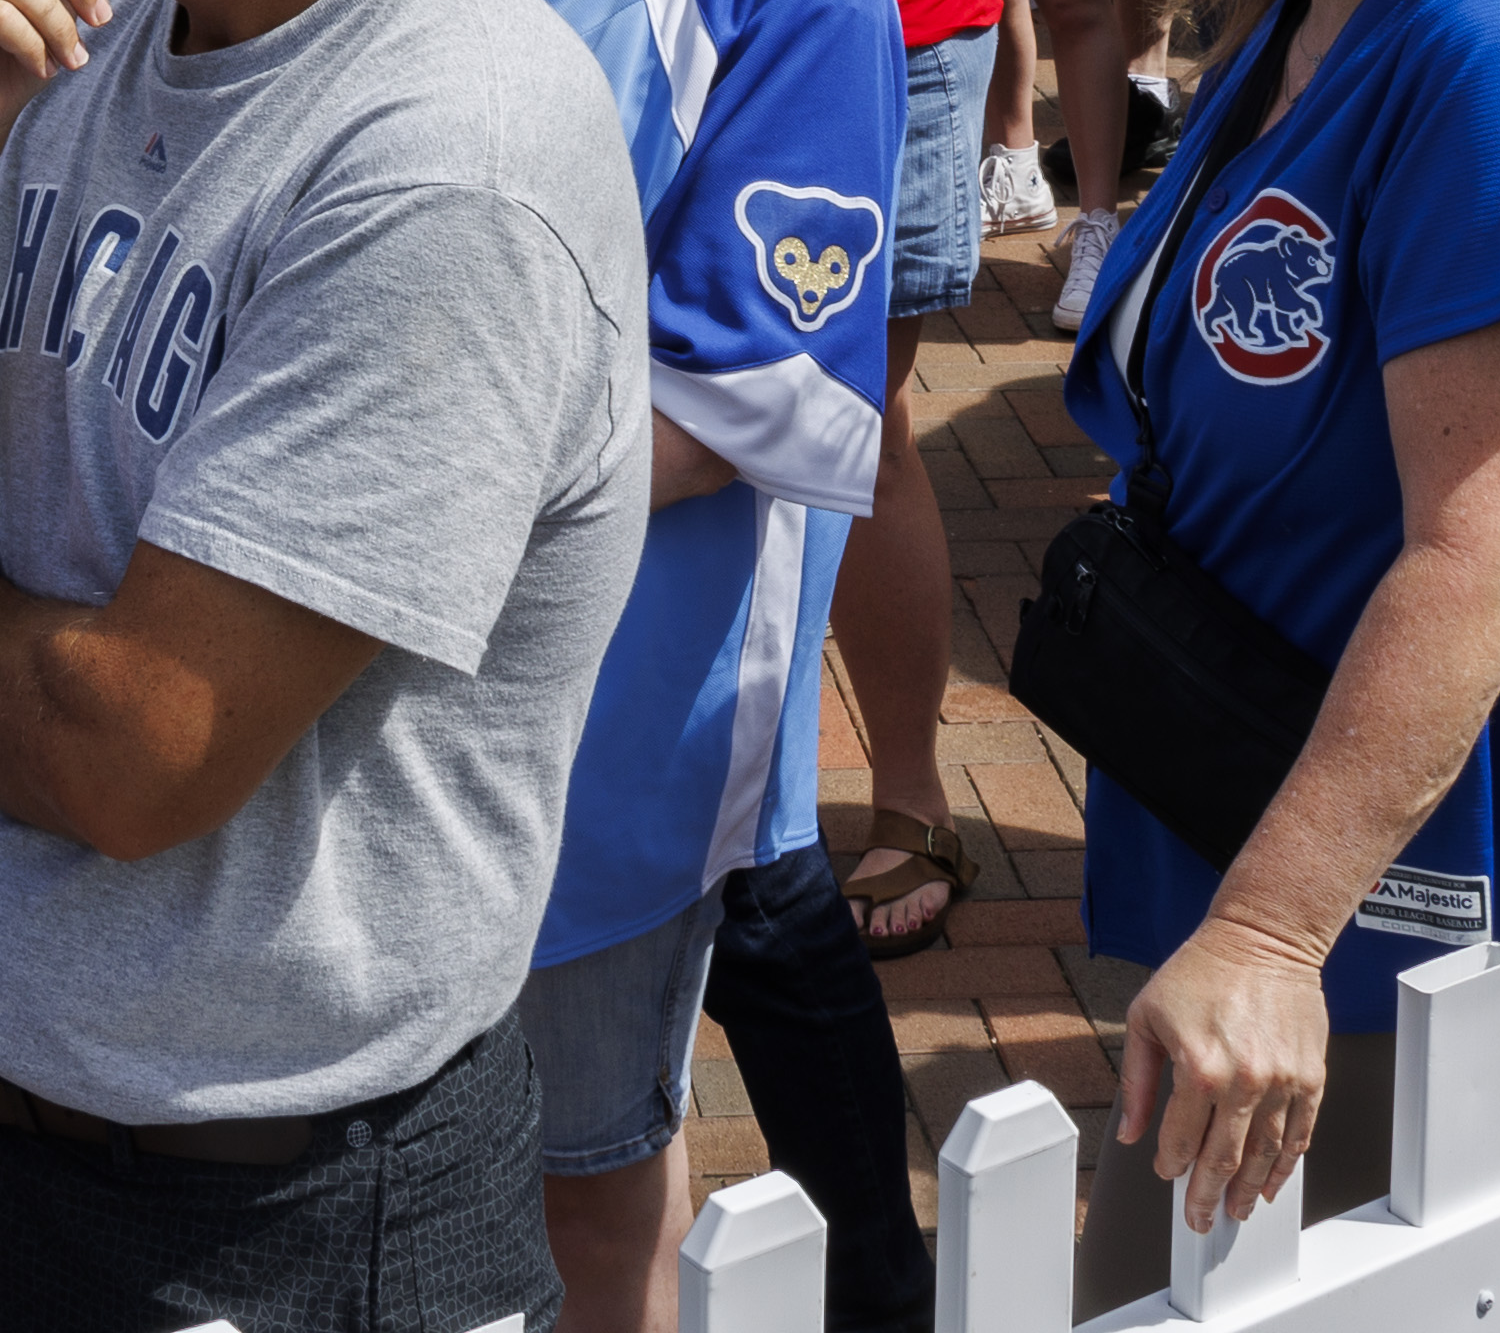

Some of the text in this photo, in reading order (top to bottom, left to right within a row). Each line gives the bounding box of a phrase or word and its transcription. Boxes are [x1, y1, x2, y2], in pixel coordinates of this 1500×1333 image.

[1398, 882, 1472, 910] Majestic
[1365, 903, 1483, 931] MAJOR LEAGUE BASEBALL
